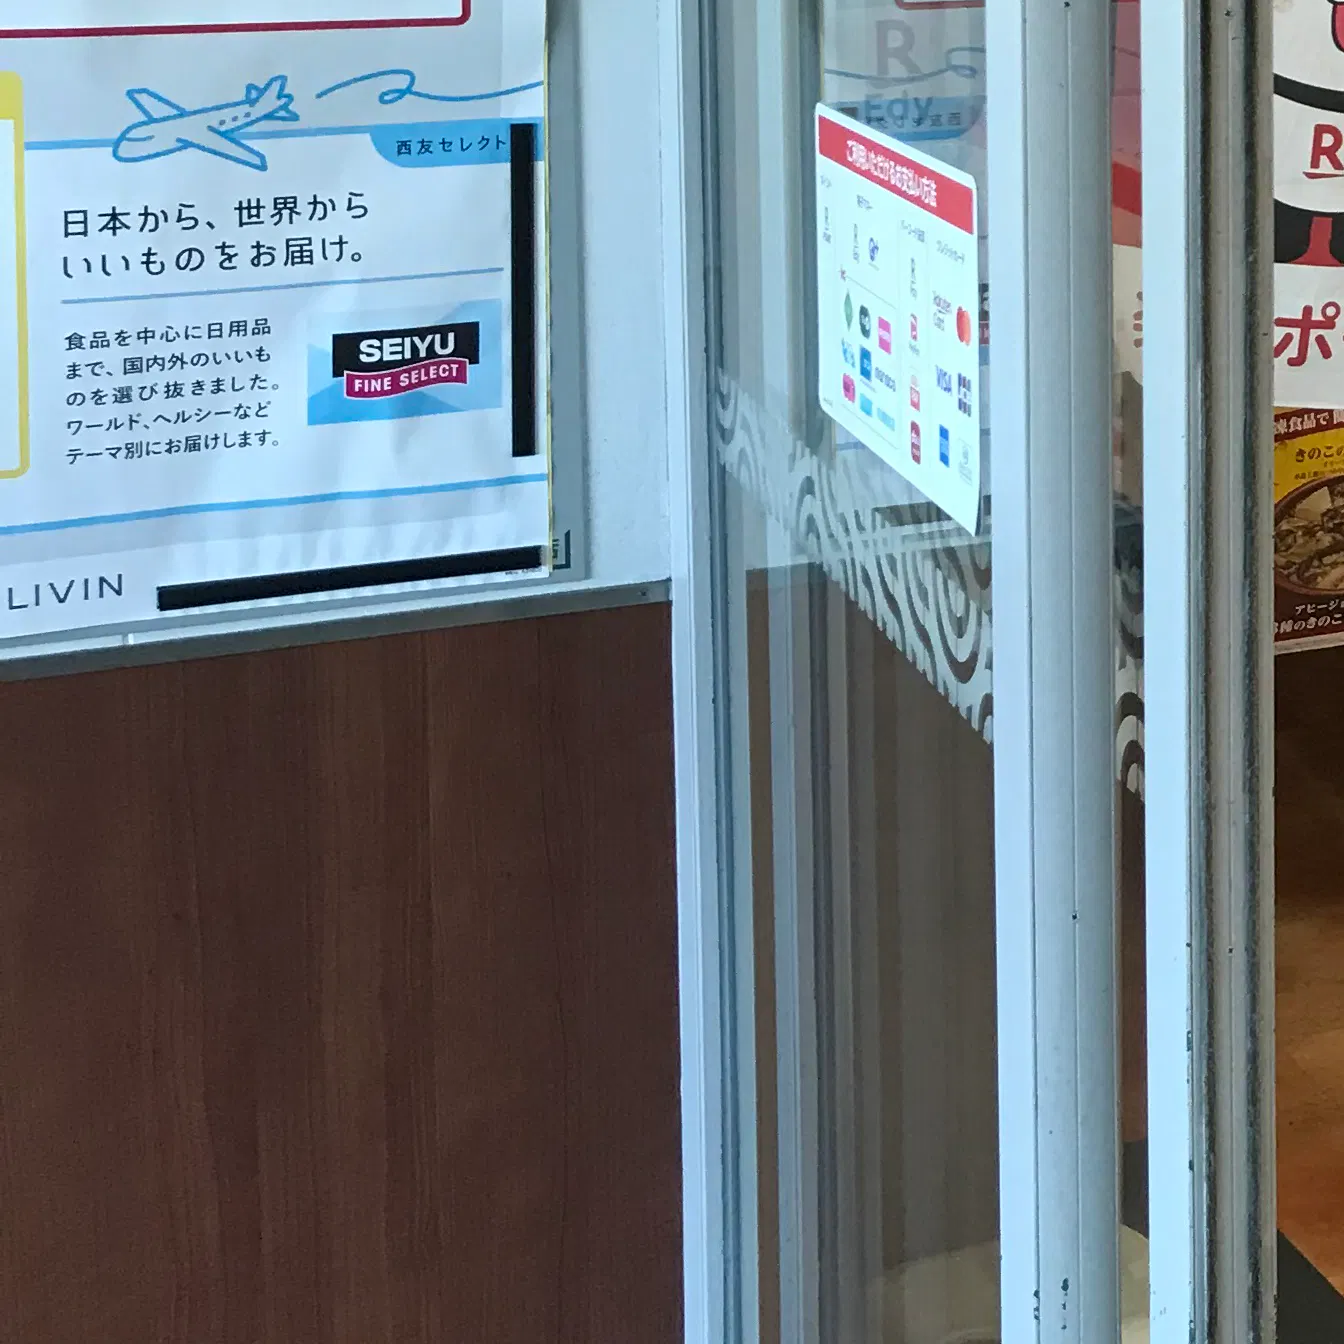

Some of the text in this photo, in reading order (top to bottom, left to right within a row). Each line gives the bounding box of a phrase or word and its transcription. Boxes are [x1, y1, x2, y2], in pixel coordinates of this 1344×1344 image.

[396, 134, 508, 158] 西友セレクト
[63, 236, 367, 279] いいものをお届け。
[64, 316, 272, 352] 食品を中心に日用品
[358, 331, 457, 364] SEIYU
[64, 347, 272, 380] まで、国内外のいいも
[353, 364, 461, 394] FINE SELECT
[64, 373, 280, 407] のを選び抜きました。
[65, 400, 272, 435] ワールド、ヘルシーなど
[65, 430, 280, 465] テーマ別にお届けします。
[7, 573, 124, 610] LIVIN
